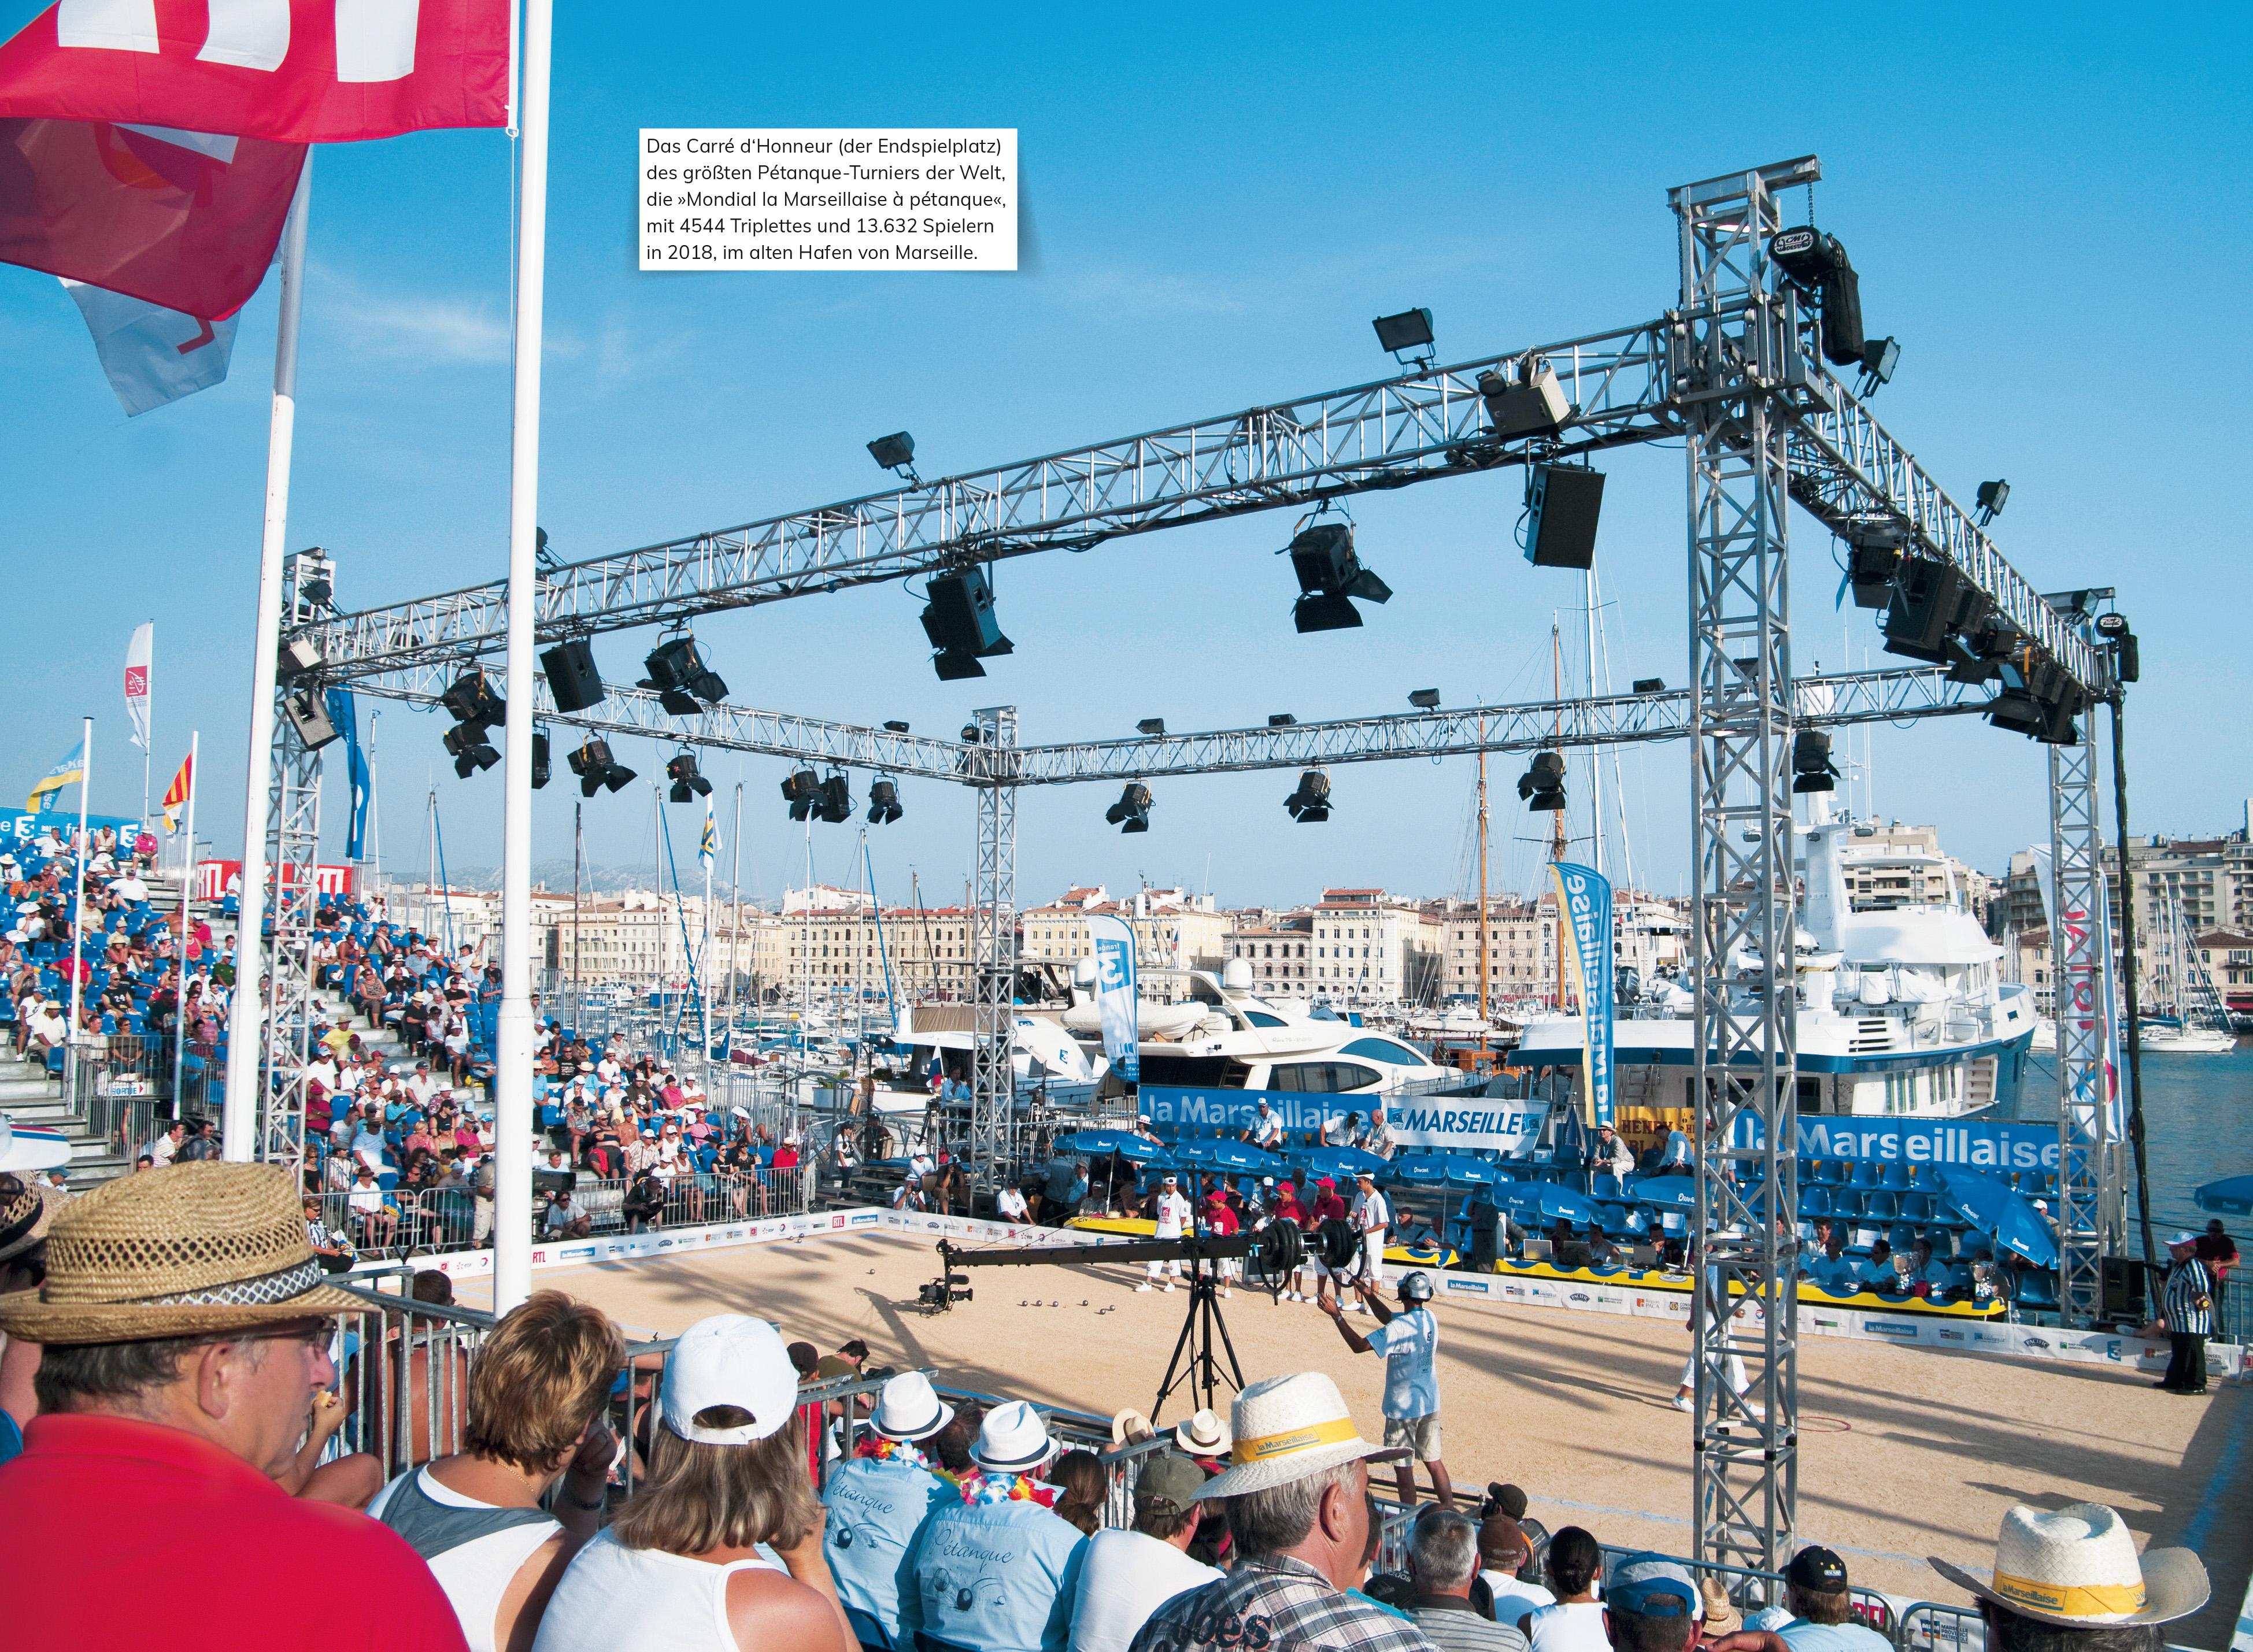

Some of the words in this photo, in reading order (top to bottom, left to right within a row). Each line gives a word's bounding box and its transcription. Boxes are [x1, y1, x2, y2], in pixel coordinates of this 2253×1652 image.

[114, 994, 125, 1003] 24
[1149, 1095, 1173, 1121] la
[1405, 1109, 1522, 1136] MARSEILLE
[833, 1217, 844, 1227] RTL
[532, 1251, 546, 1264] RTL
[1455, 1283, 1486, 1292] Marseillaise
[1874, 1325, 1914, 1335] Marseillaise
[1257, 1442, 1265, 1450] la
[1265, 1432, 1315, 1450] Marseillaise
[830, 1471, 896, 1517] Pétanque
[928, 1528, 1015, 1573] Pétanque
[2007, 1584, 2058, 1605] Marseillaise
